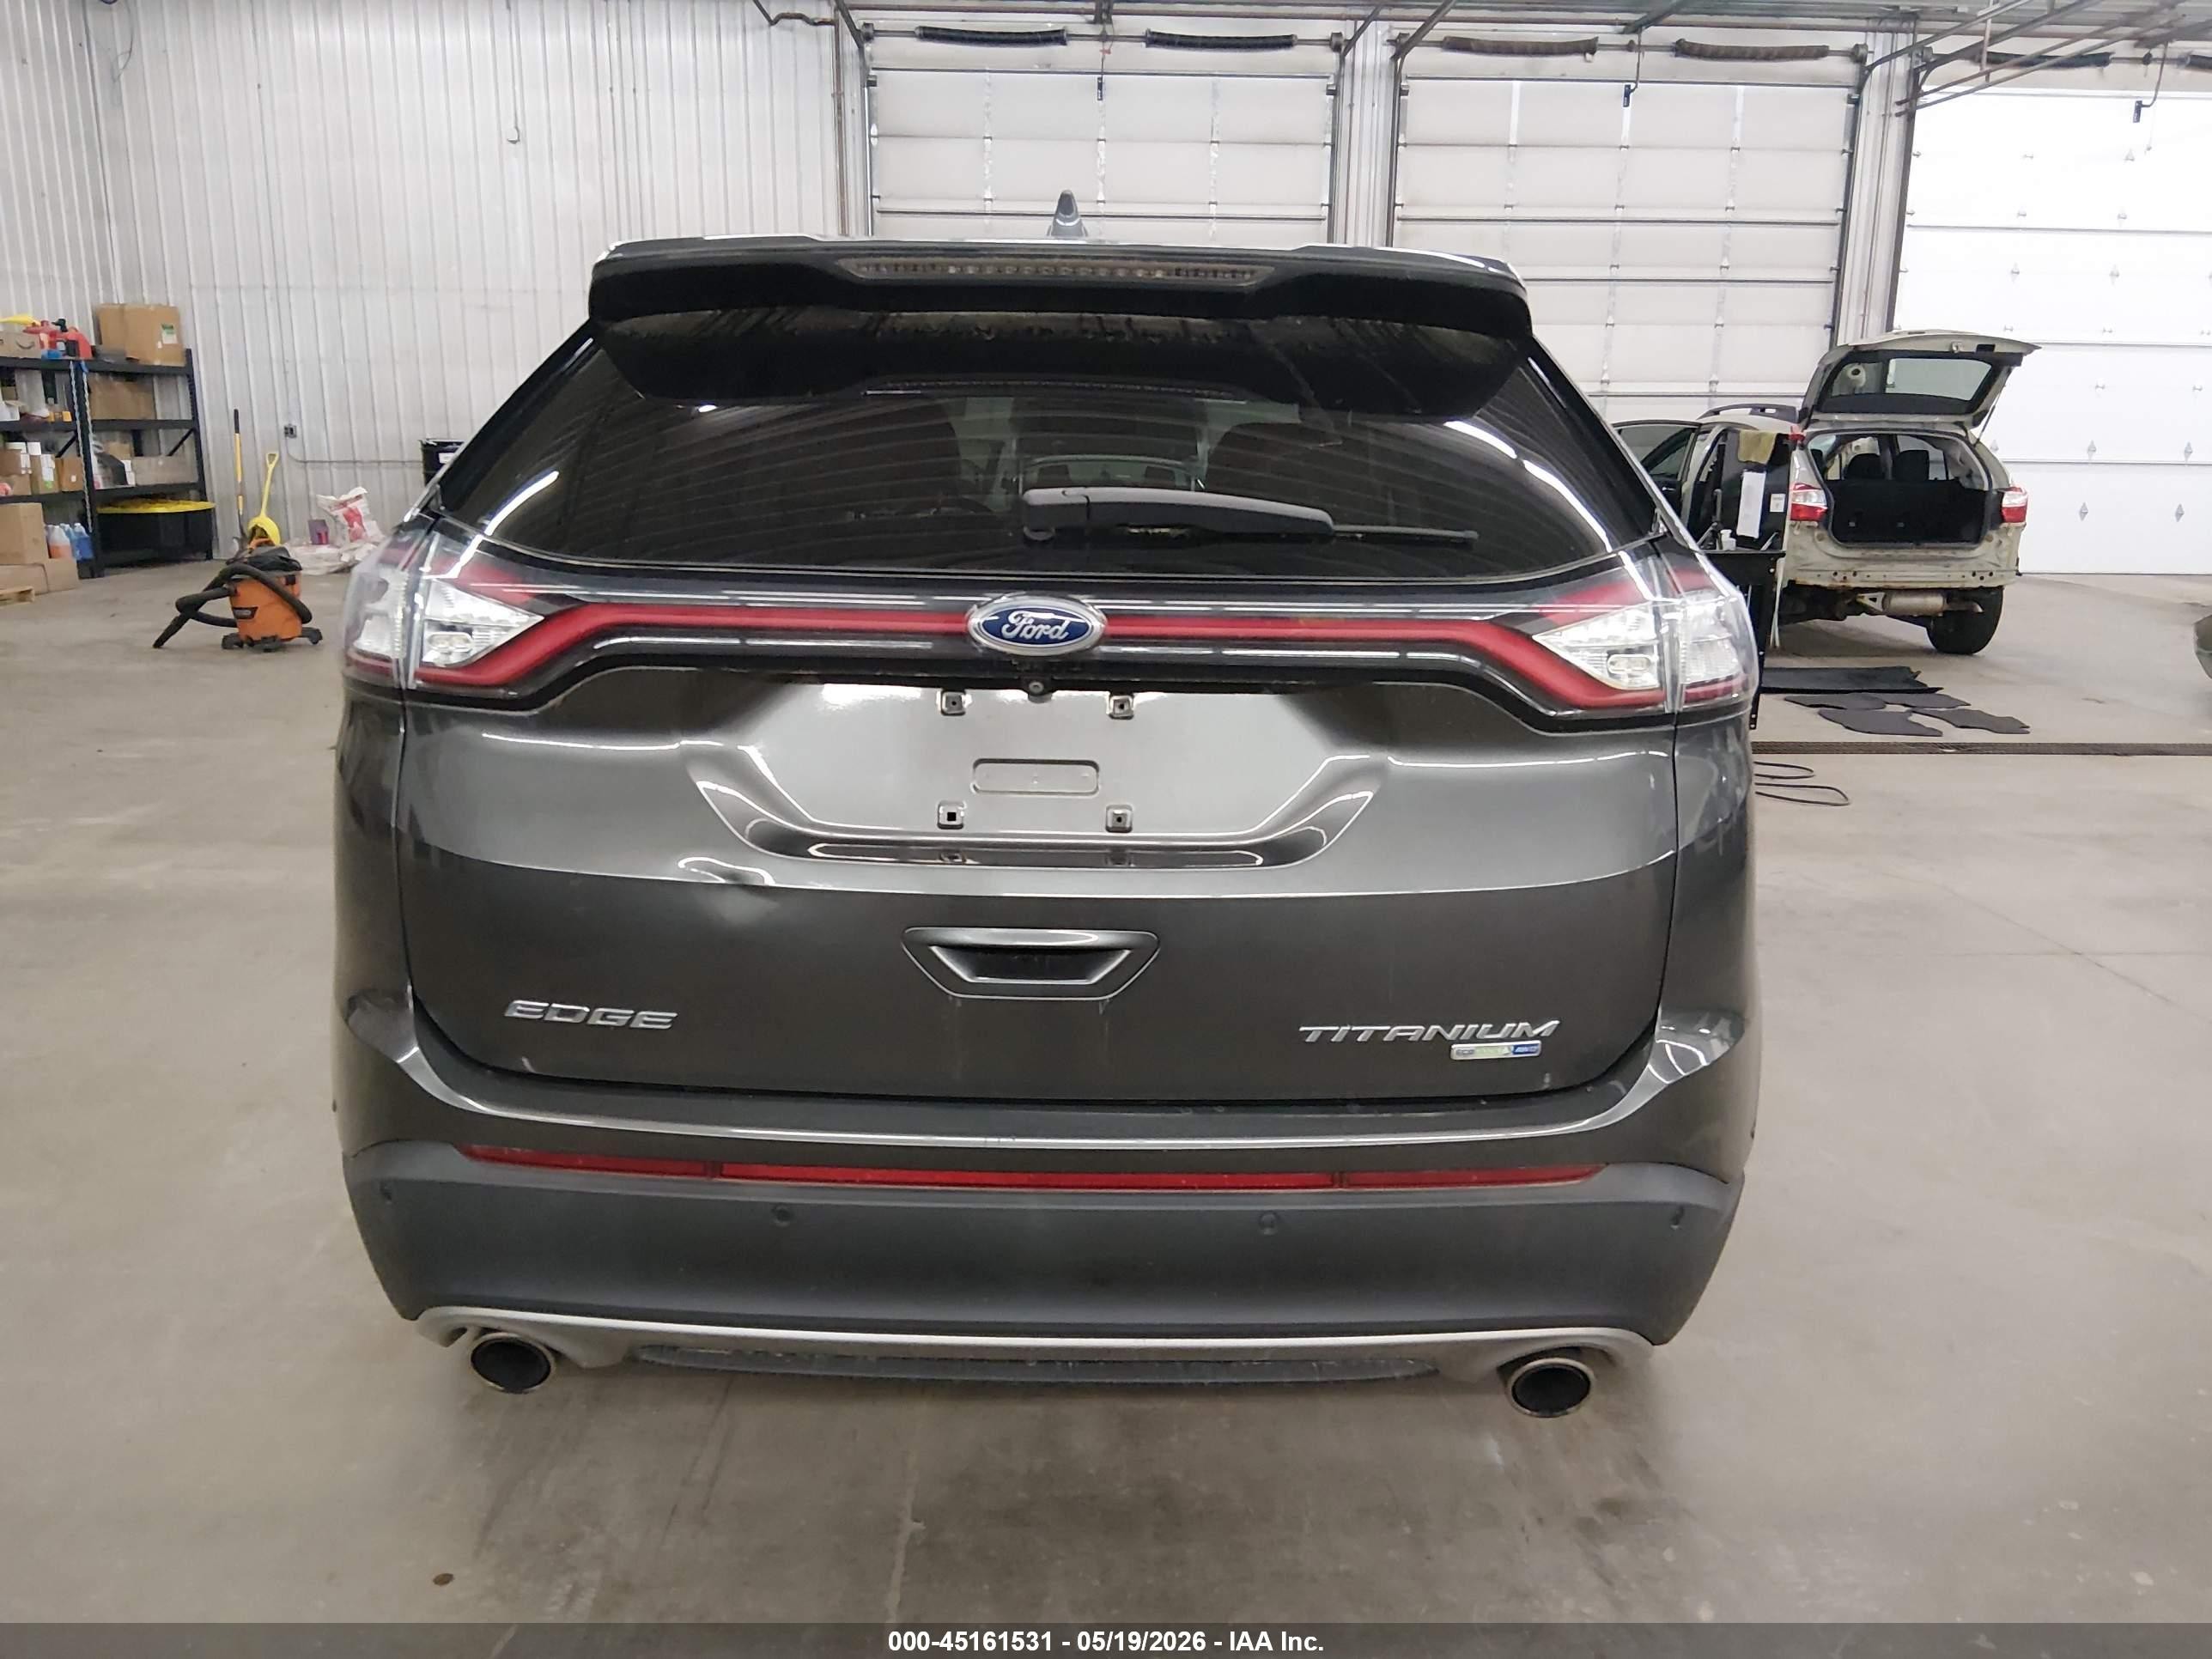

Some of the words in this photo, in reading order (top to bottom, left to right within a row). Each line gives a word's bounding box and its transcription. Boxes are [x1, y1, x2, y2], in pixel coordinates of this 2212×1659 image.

[1001, 610, 1069, 641] Ford
[504, 1000, 678, 1030] EDGE
[1299, 1020, 1560, 1042] TITANIUM
